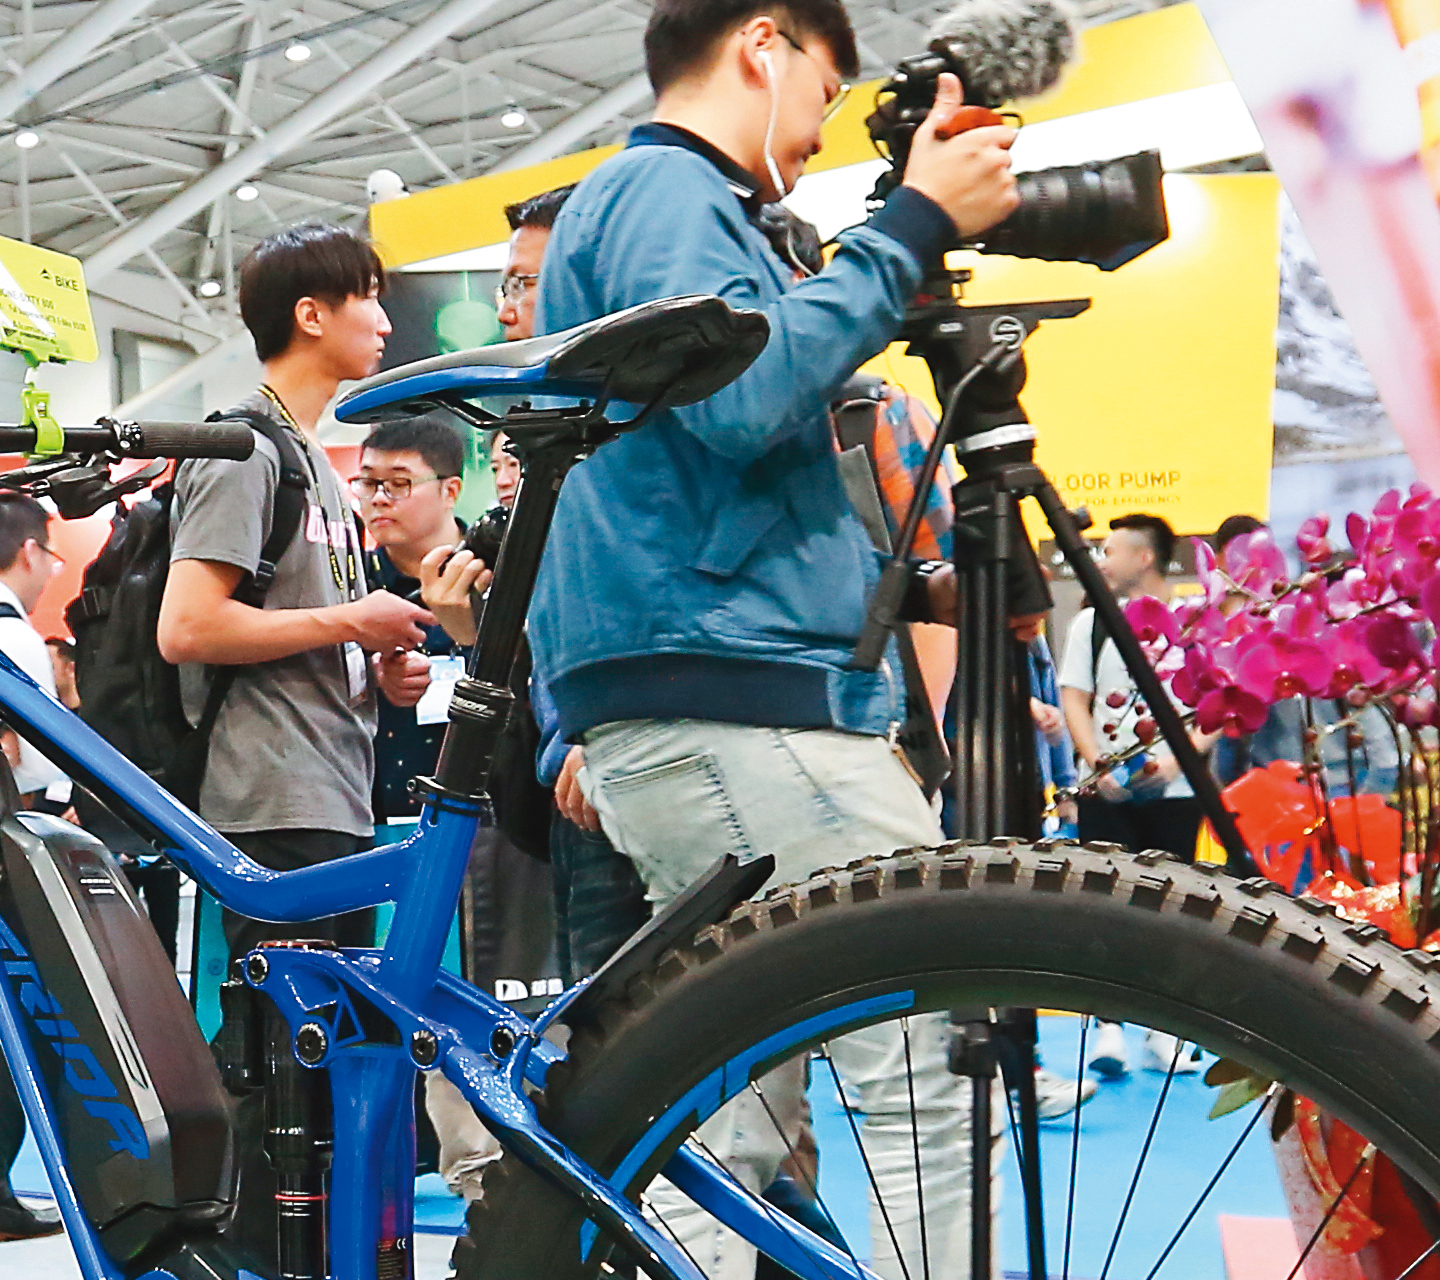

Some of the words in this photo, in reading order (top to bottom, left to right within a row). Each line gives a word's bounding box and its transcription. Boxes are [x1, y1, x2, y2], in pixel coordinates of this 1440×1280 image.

[55, 275, 80, 292] BIKE
[1051, 473, 1110, 491] LOOR
[1120, 471, 1181, 489] PUMP
